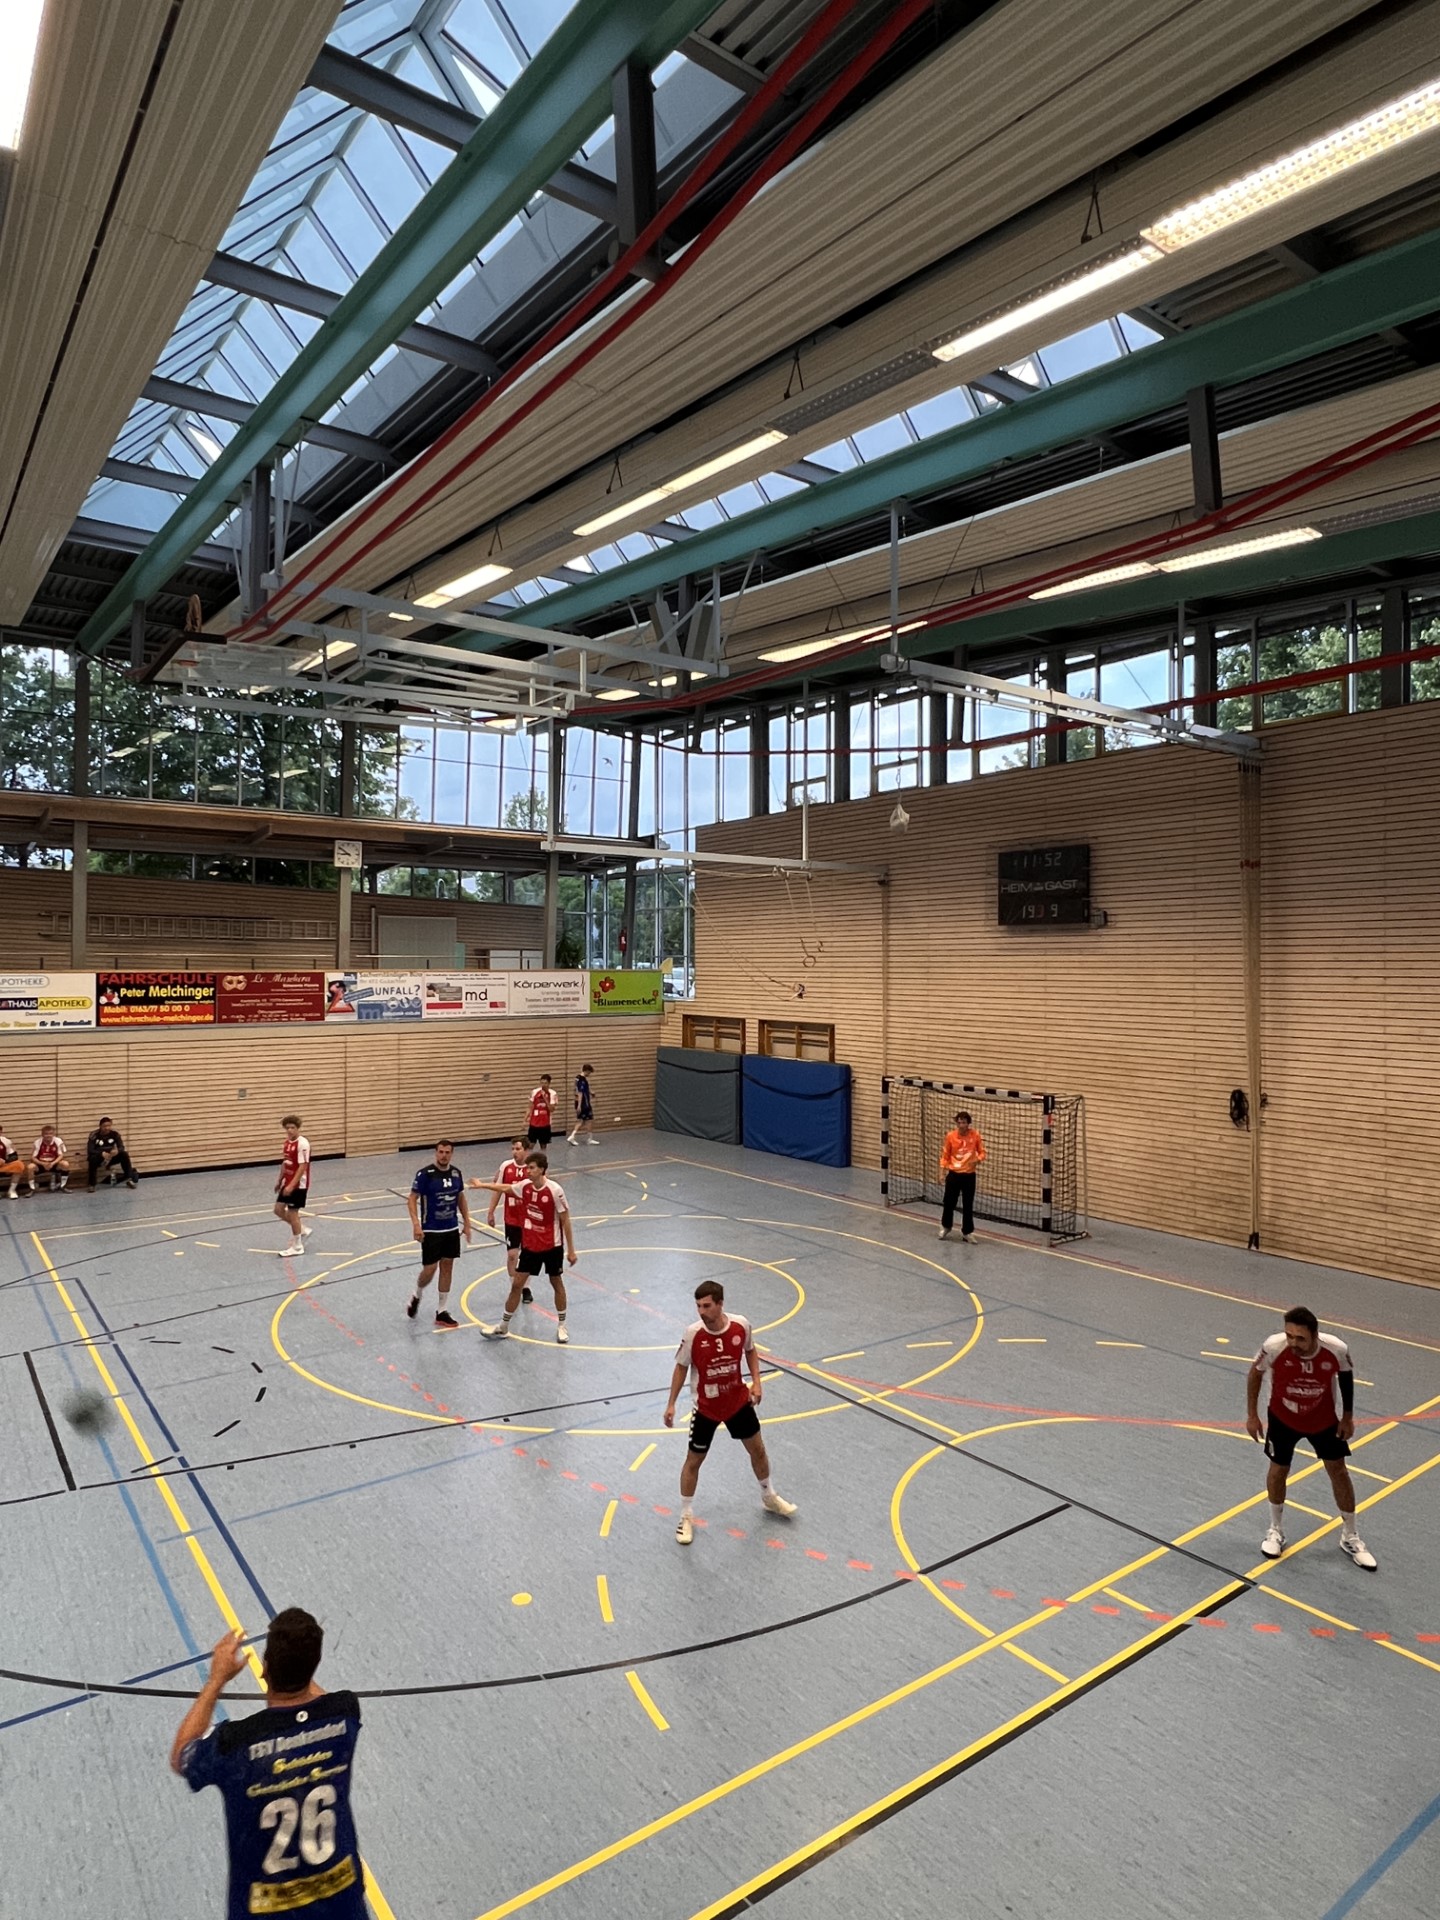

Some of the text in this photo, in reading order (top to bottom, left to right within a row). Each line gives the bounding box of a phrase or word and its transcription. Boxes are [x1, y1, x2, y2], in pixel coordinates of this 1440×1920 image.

[1000, 882, 1033, 894] HEIM
[1044, 879, 1078, 891] GAST
[99, 973, 214, 984] FAHRSCHULE
[513, 979, 580, 989] Körperwerk
[120, 985, 215, 999] Peter Melchinger
[375, 984, 421, 995] UNFALL?
[465, 988, 488, 1001] md
[38, 999, 87, 1008] APOTHEKE
[597, 998, 652, 1006] Blumenecke
[715, 1338, 724, 1352] 3
[1300, 1360, 1313, 1374] 10
[259, 1784, 337, 1875] 26
